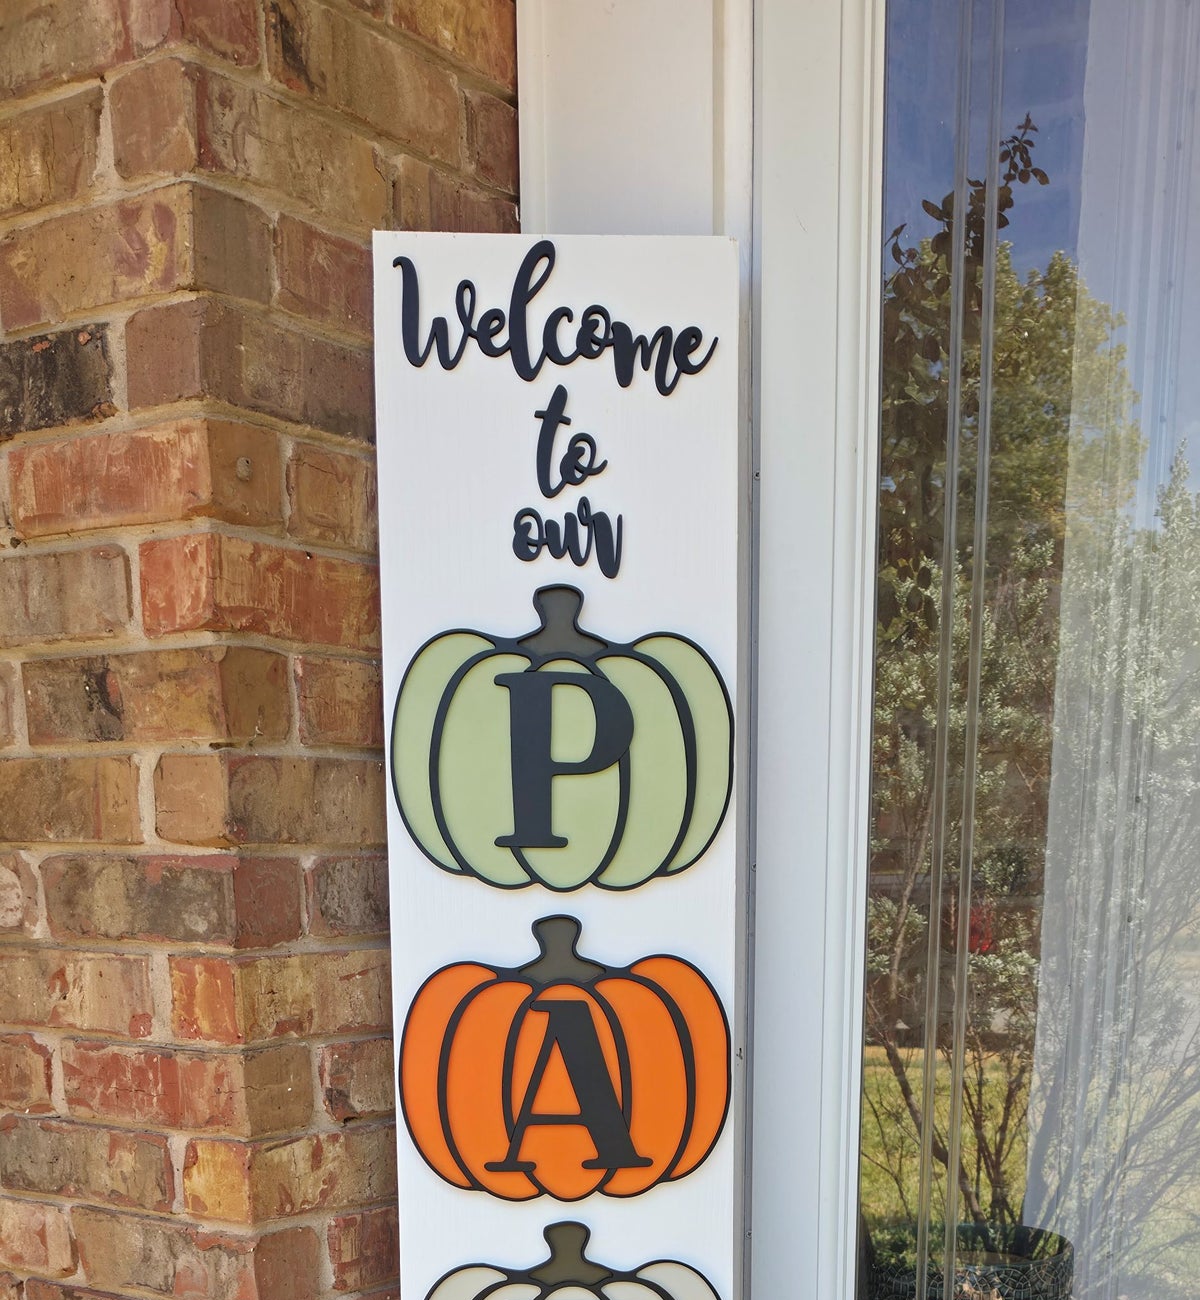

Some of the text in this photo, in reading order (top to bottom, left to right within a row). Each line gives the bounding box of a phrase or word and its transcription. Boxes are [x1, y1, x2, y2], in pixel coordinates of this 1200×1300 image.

[392, 240, 718, 396] Welcome
[534, 384, 608, 498] to
[512, 496, 623, 579] our
